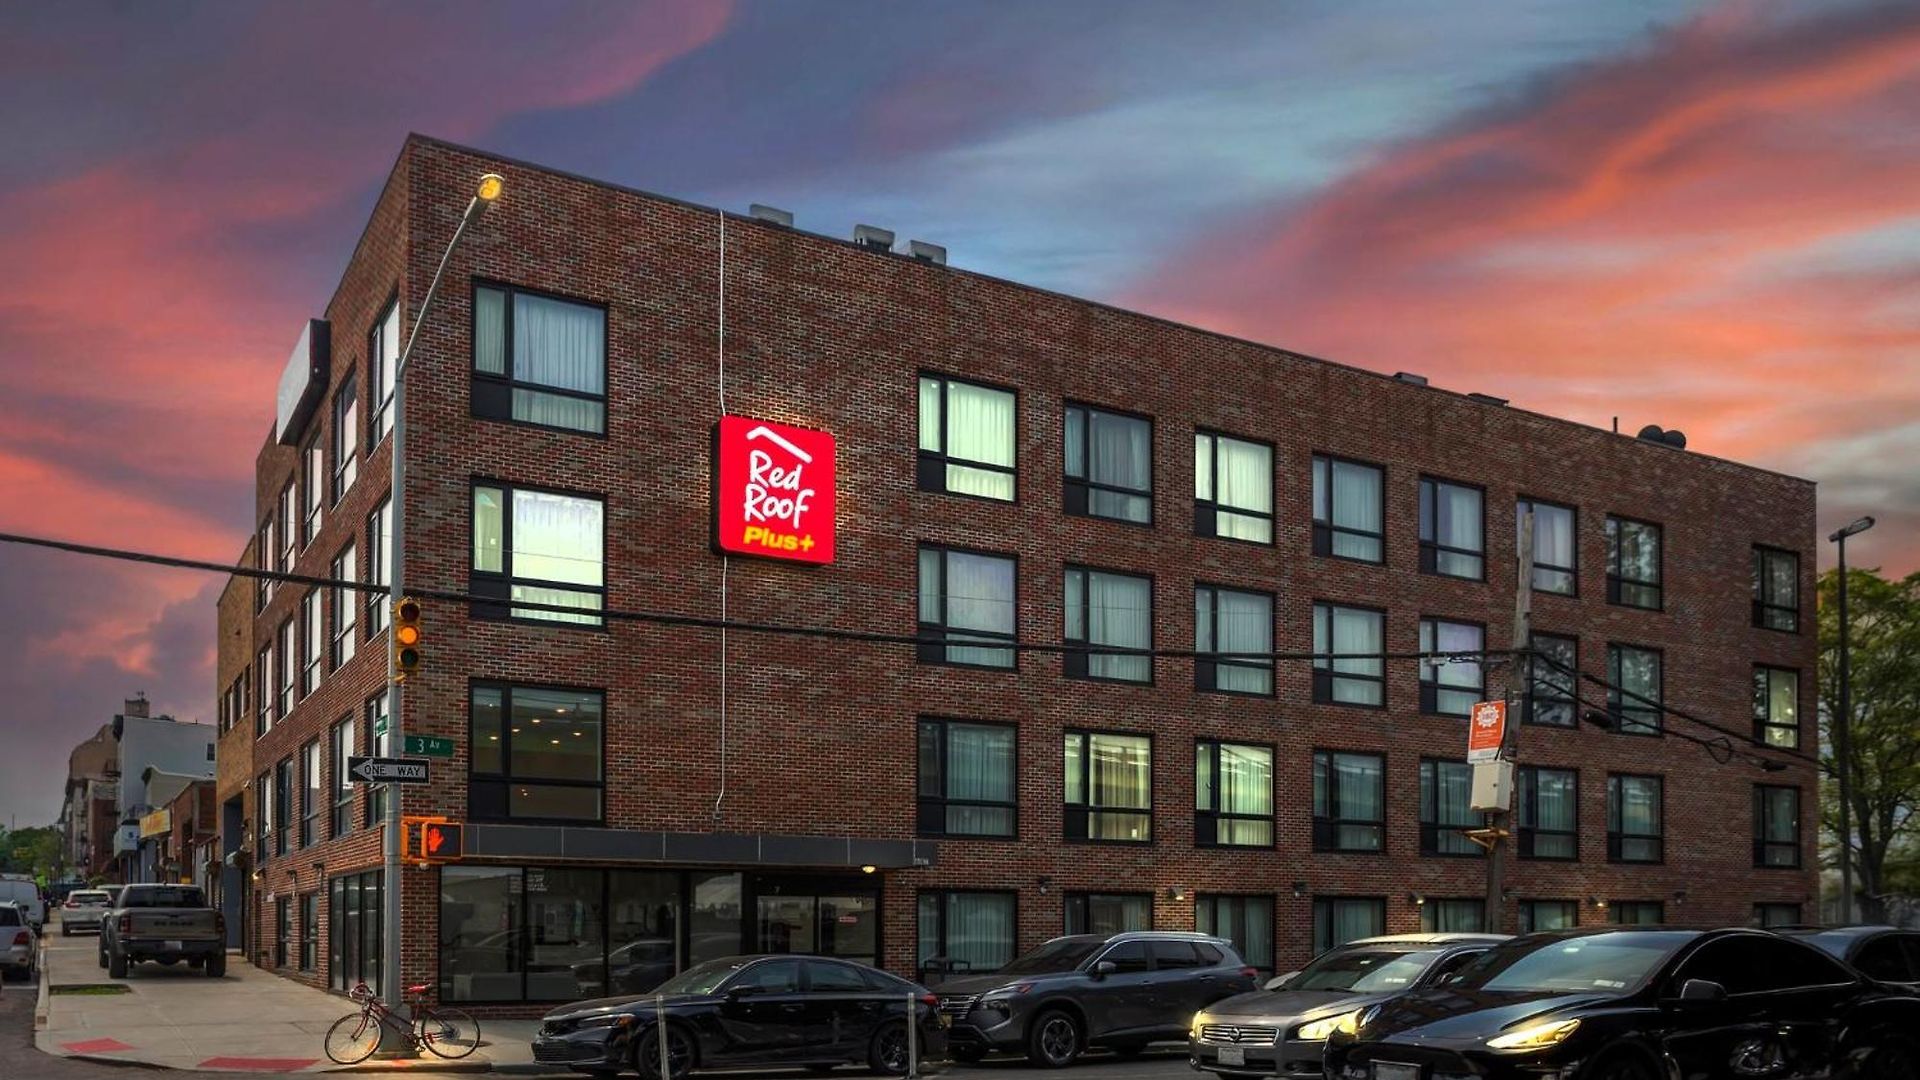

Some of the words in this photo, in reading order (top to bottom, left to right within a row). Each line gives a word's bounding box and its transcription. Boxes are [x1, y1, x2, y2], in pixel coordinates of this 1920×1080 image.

[750, 449, 803, 491] Red
[744, 483, 815, 529] Roof
[417, 738, 425, 753] 3
[364, 764, 385, 777] ONE
[397, 766, 421, 778] WAY
